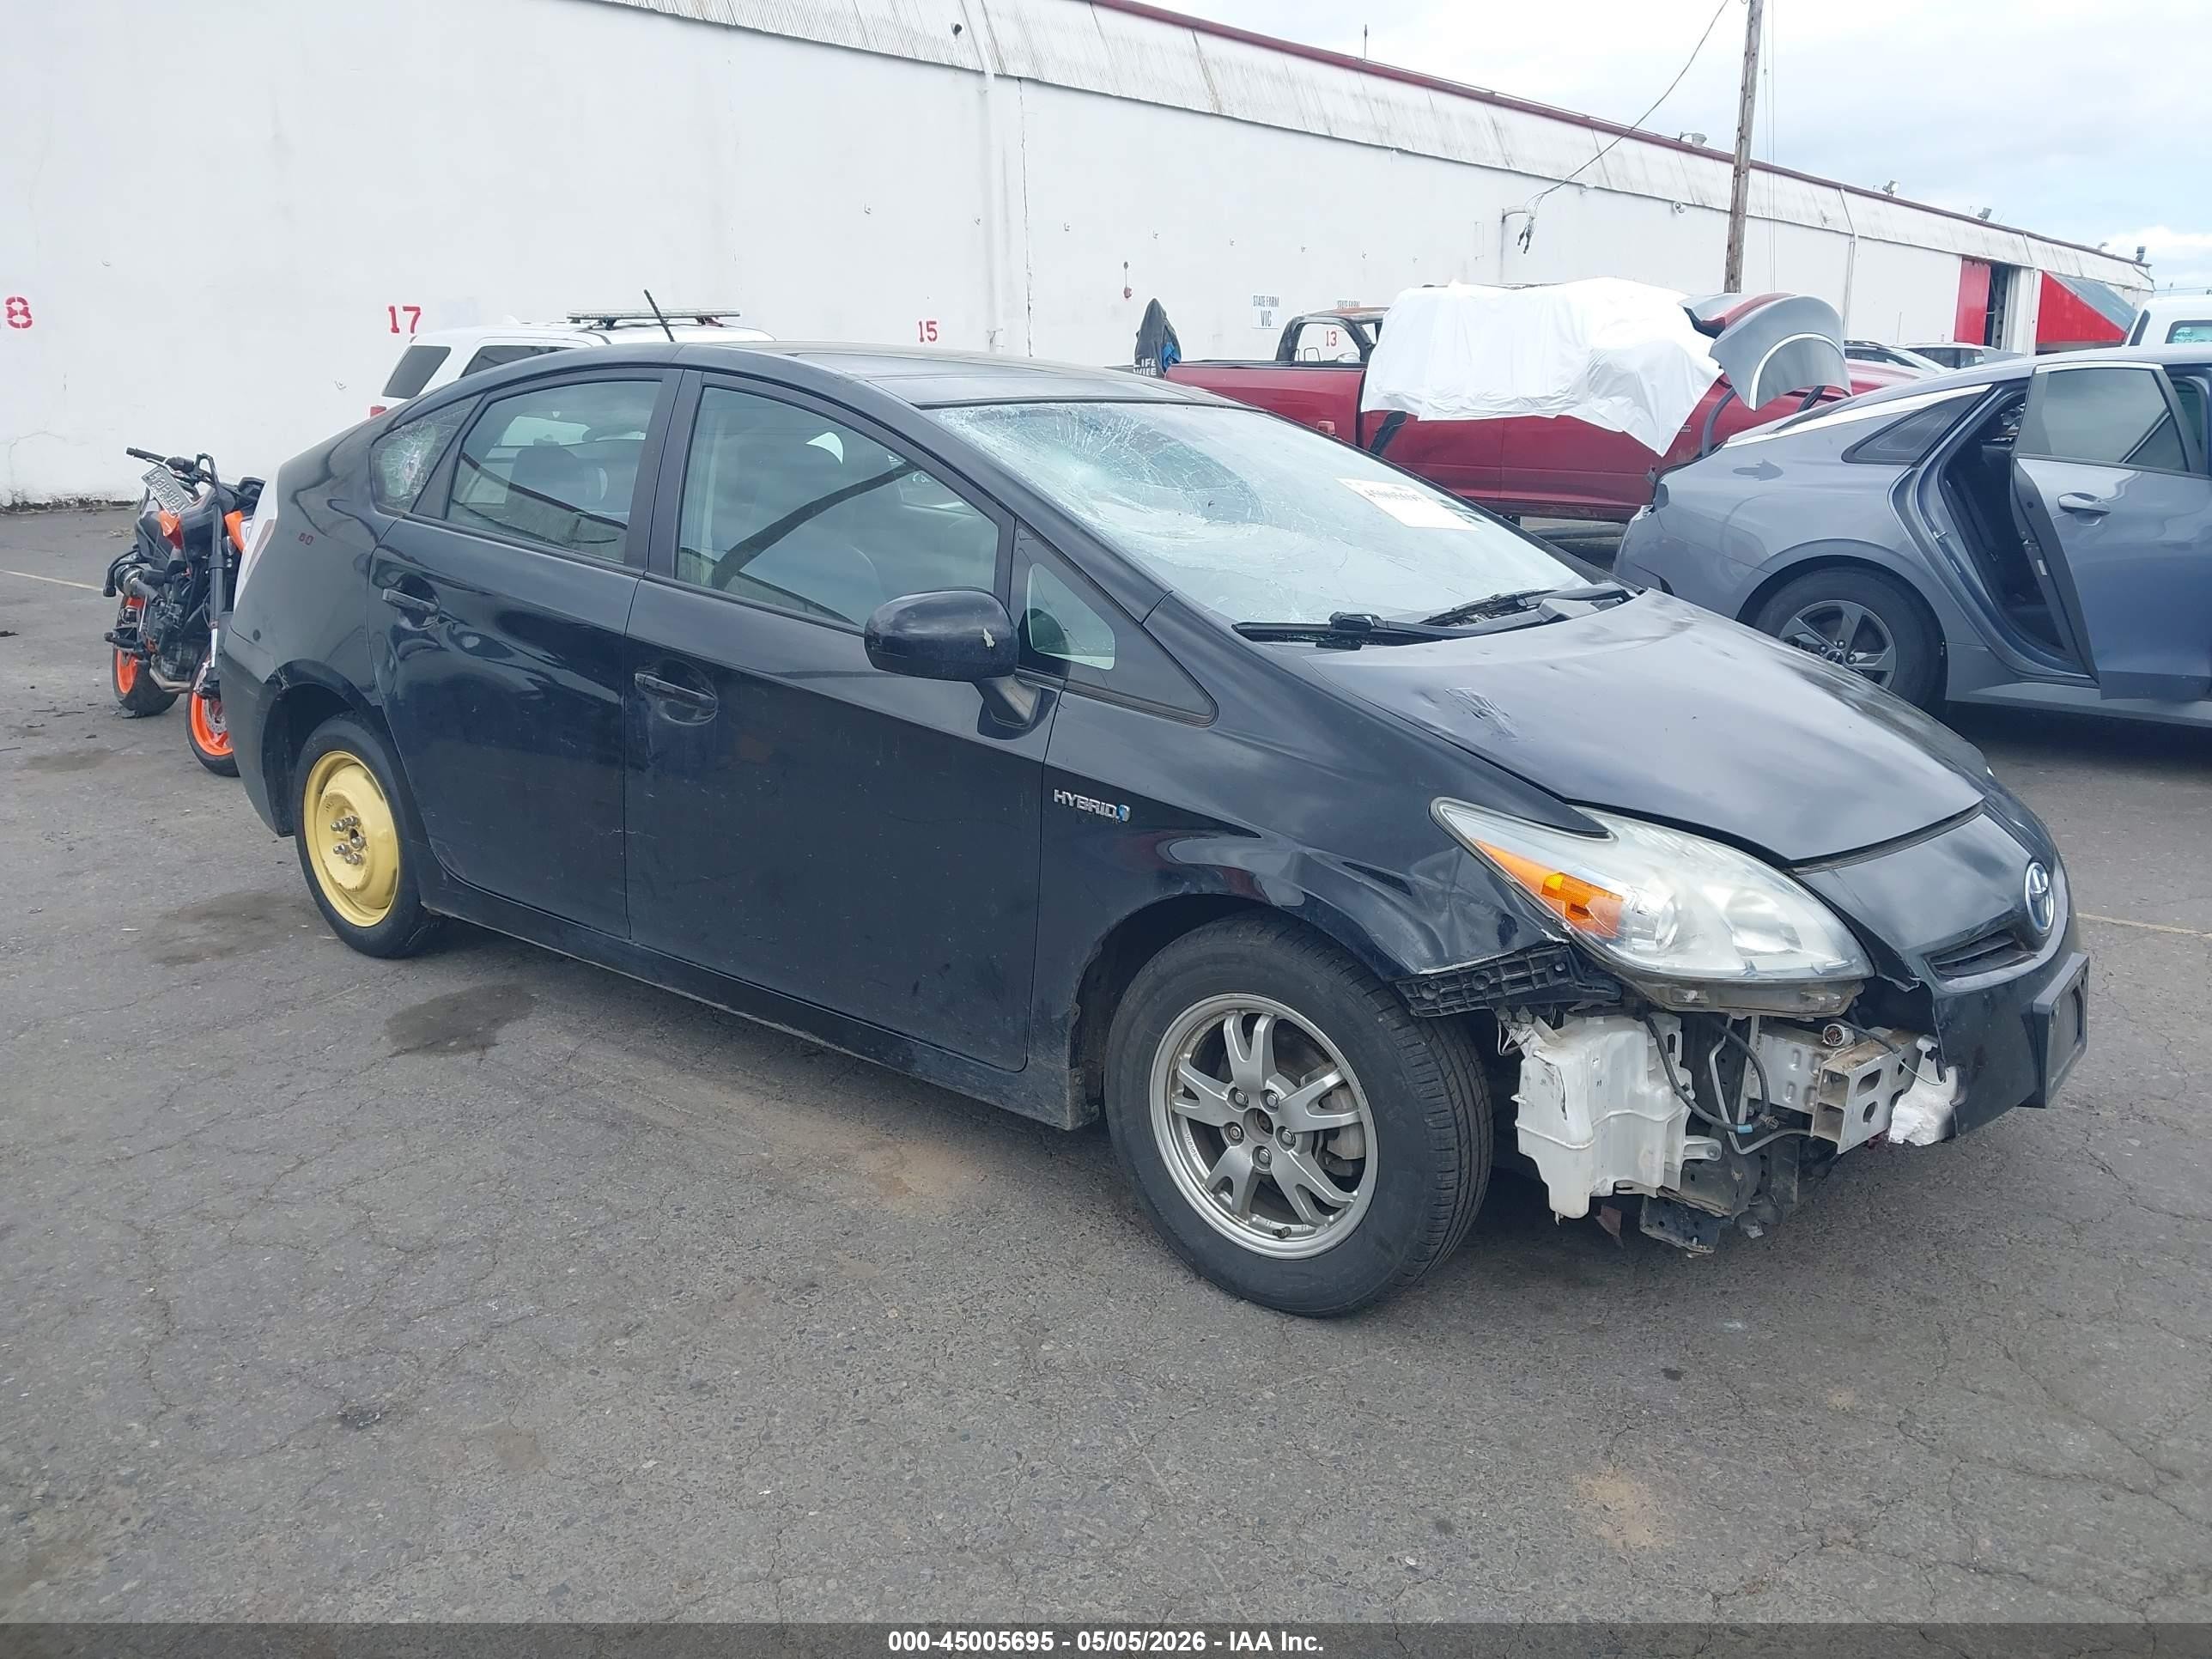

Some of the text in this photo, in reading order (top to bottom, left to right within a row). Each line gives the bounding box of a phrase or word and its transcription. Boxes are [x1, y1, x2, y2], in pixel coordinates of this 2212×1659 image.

[1253, 295, 1279, 307] STATE FARM
[388, 306, 421, 334] 17
[1261, 310, 1272, 327] VIC
[919, 320, 938, 343] 15
[1326, 331, 1337, 347] 13
[1133, 357, 1157, 368] LIFE
[1054, 788, 1117, 818] HYBRID
